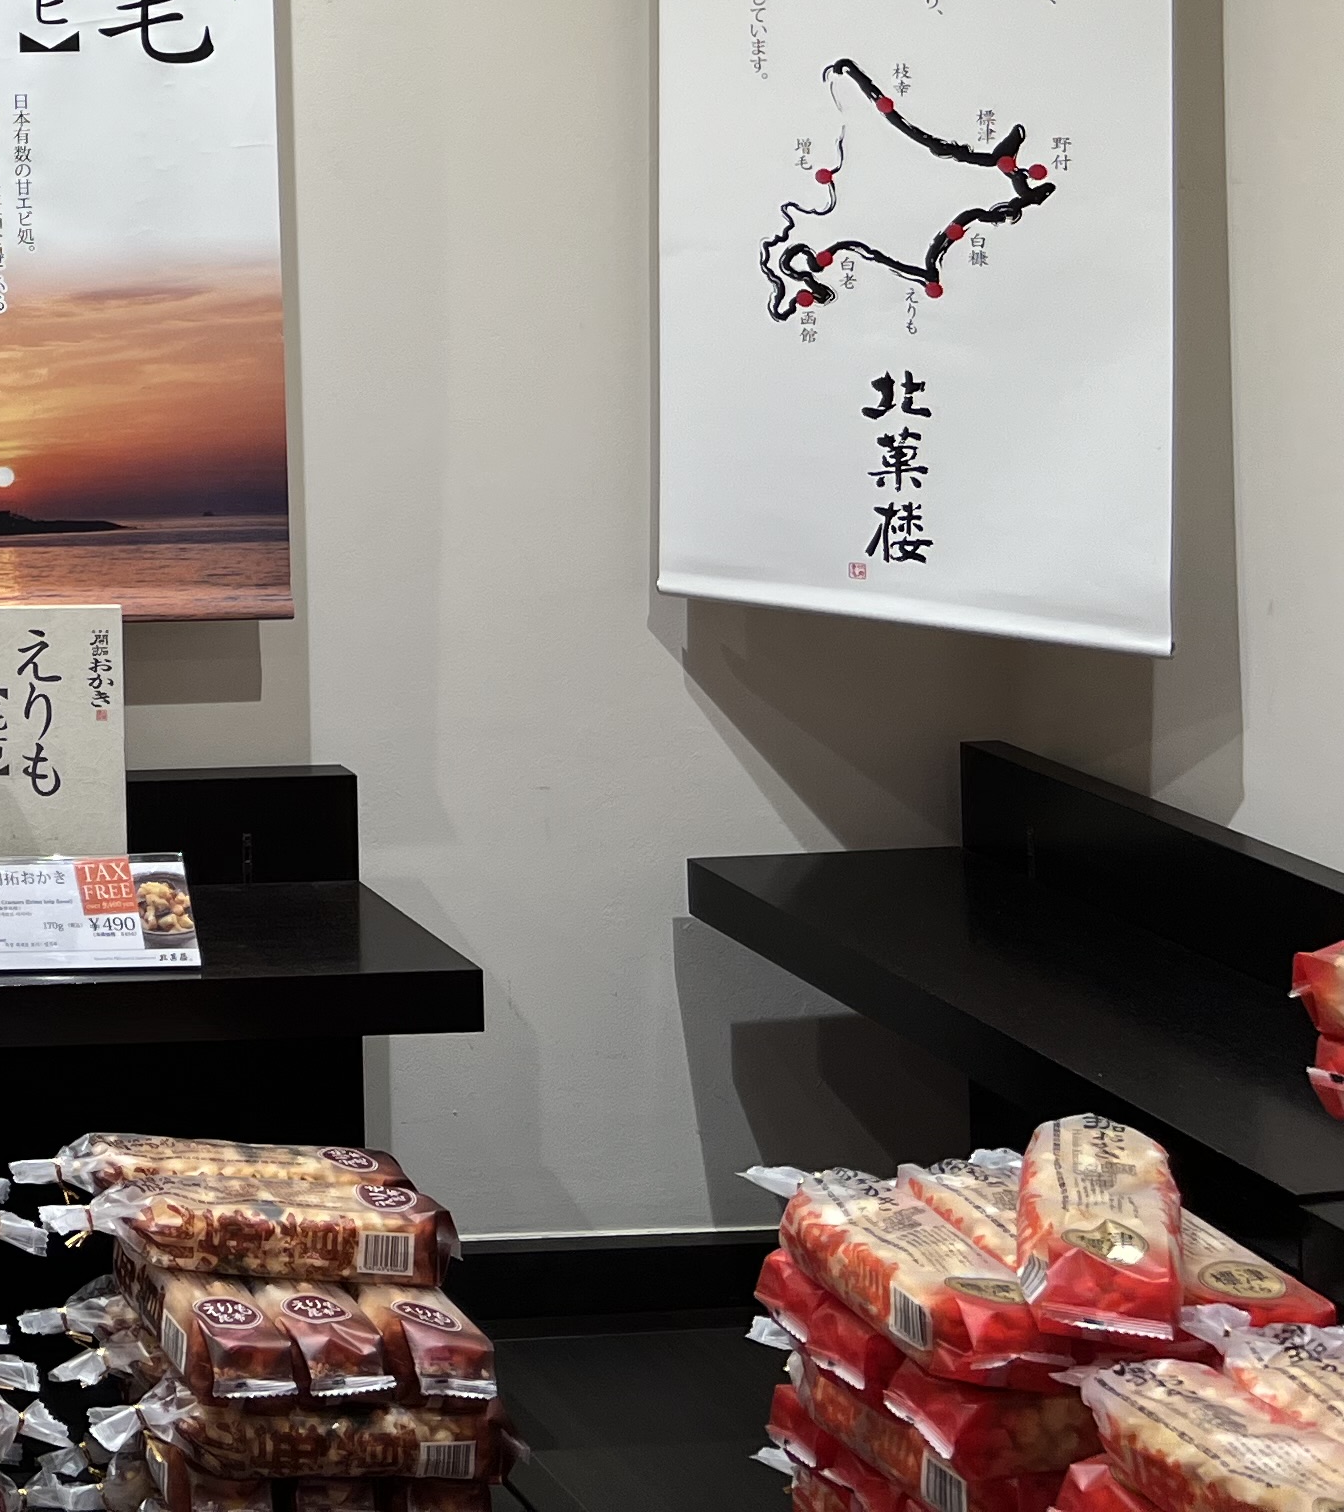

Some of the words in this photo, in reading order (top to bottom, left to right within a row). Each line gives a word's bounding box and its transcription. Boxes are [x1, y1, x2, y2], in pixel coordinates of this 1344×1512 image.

[893, 63, 911, 97] 枝幸
[795, 138, 812, 171] 増毛
[1052, 135, 1072, 171] 野付
[13, 93, 35, 252] 日本有数の甘エビ処。
[840, 256, 857, 290] 白老
[800, 311, 818, 343] 函館
[905, 288, 917, 335] えりも
[862, 370, 933, 562] 北菓楼
[18, 630, 61, 796] えりも
[79, 862, 128, 882] TAX
[84, 884, 133, 899] FREE
[43, 922, 64, 931] 170g
[89, 917, 135, 931] ¥490
[292, 1296, 341, 1314] えりも
